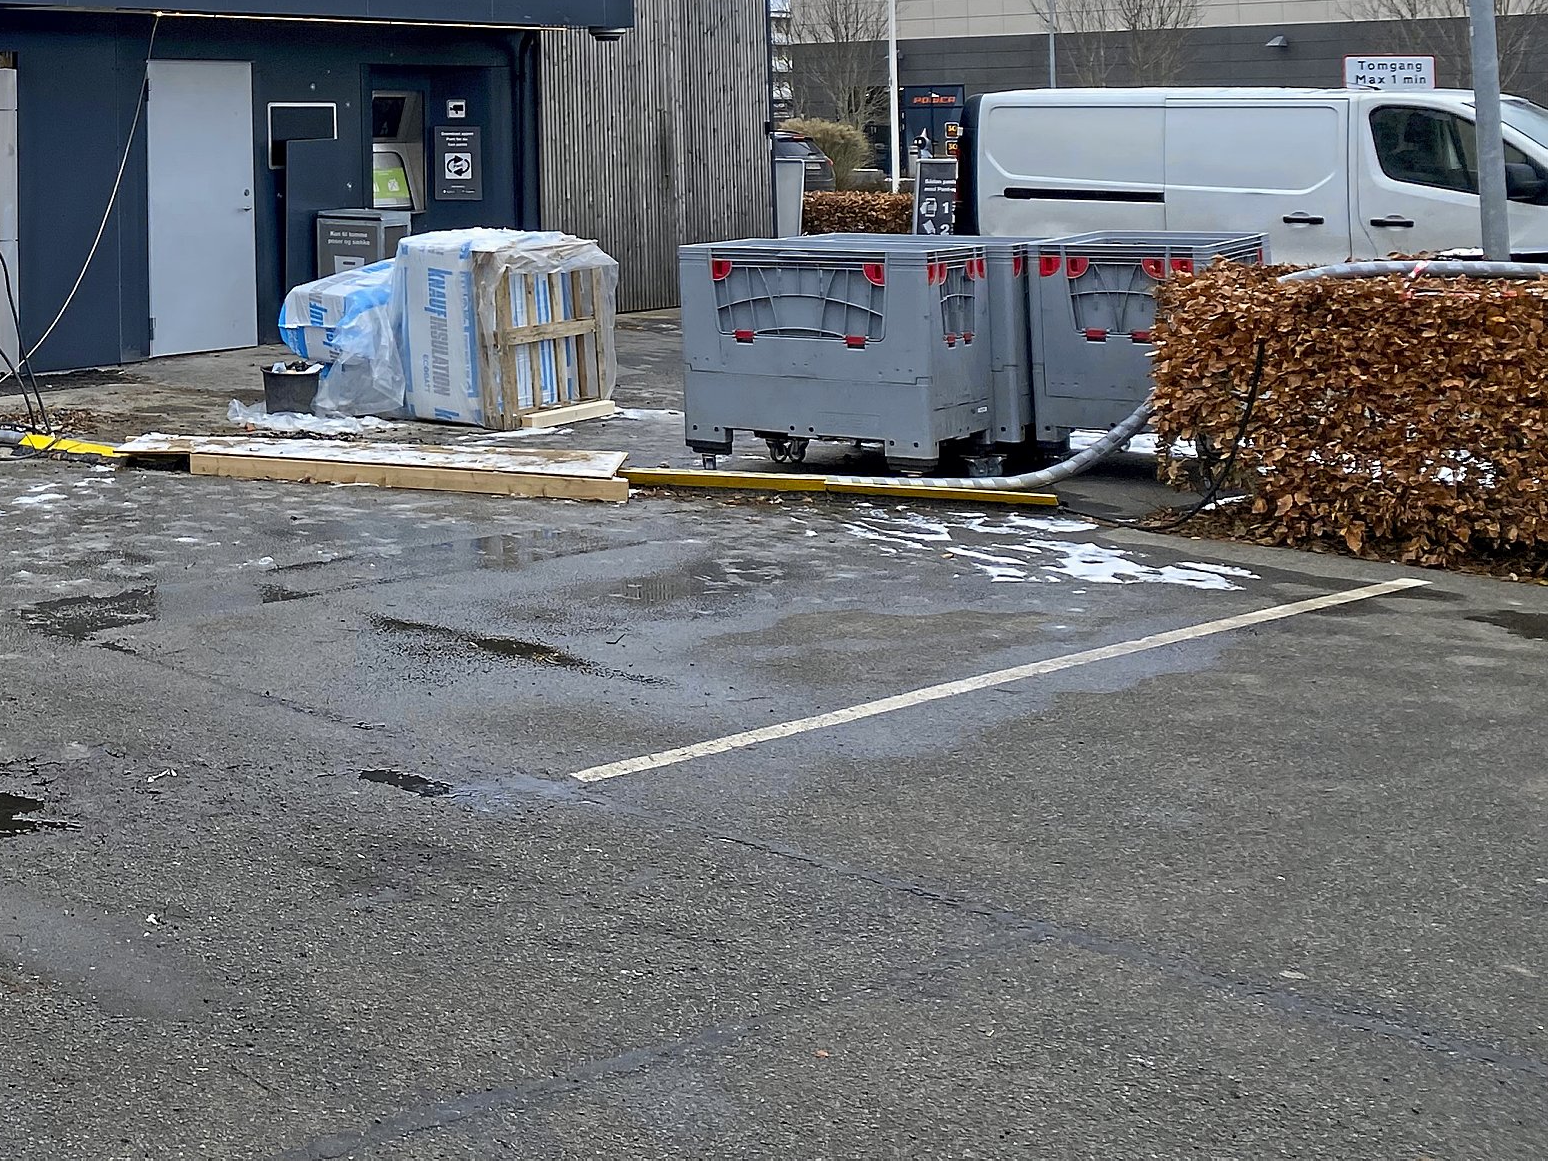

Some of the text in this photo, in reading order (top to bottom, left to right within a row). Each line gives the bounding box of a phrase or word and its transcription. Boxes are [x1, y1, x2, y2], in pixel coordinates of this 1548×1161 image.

[1357, 60, 1423, 72] Tomgang
[1355, 74, 1427, 85] Max 1 min
